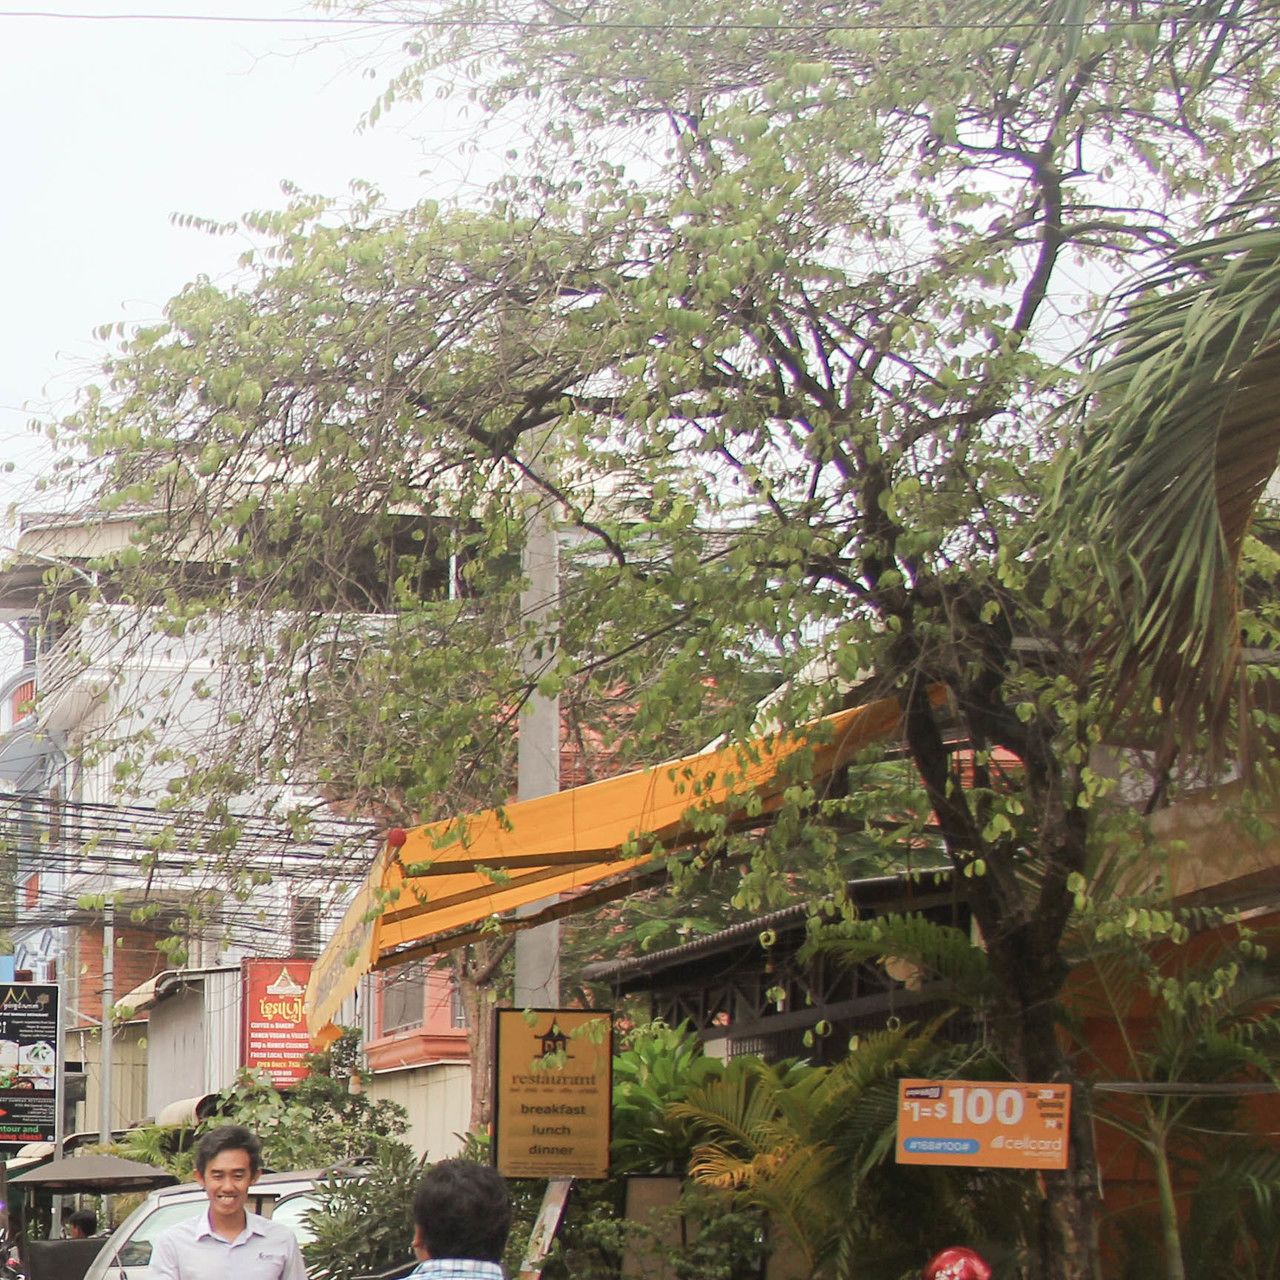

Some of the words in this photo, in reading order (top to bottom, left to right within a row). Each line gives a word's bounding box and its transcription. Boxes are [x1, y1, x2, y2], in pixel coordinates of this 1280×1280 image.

[512, 1074, 596, 1085] restaurant
[521, 1104, 586, 1115] breakfast
[23, 1124, 39, 1133] and
[532, 1125, 571, 1136] lunch
[529, 1145, 574, 1155] dinner
